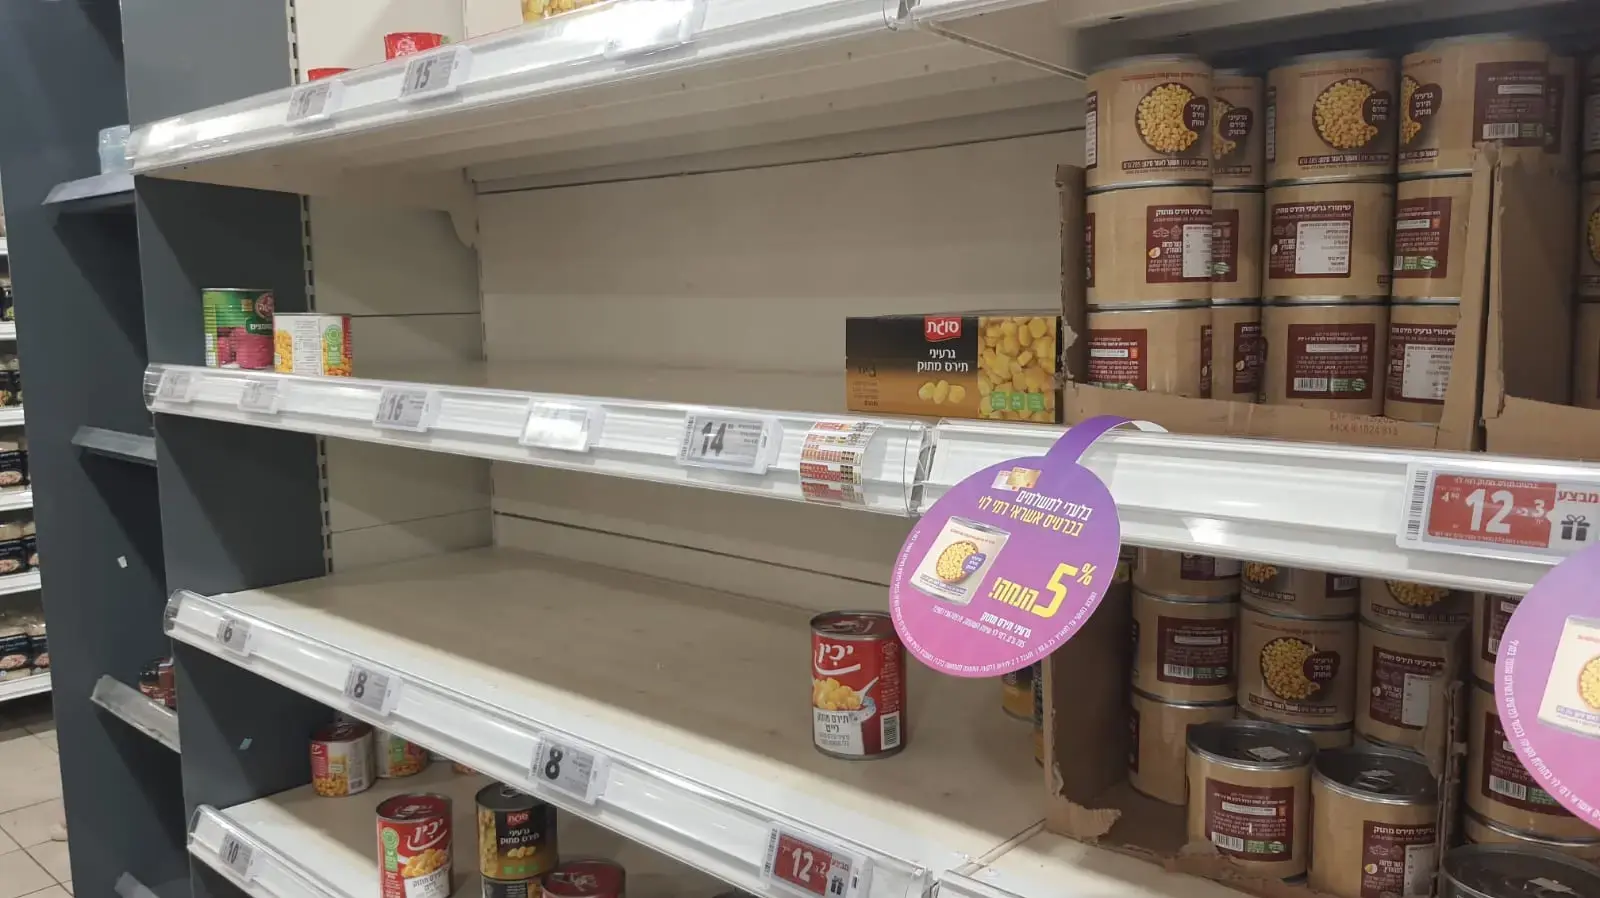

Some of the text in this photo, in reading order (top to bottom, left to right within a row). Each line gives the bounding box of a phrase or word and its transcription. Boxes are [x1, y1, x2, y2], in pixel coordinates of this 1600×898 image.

[926, 320, 960, 335] סוגת
[929, 348, 956, 359] גרעיני
[916, 361, 969, 373] תירס מתוק
[701, 421, 727, 457] 14
[1557, 490, 1600, 503] מבצע
[1016, 489, 1093, 521] בלעדי למשלמים
[1465, 488, 1514, 534] 12
[1531, 499, 1545, 518] 3
[978, 495, 1084, 537] בכרטיס אשראי רמי לוי
[988, 576, 1040, 612] הנחה!
[979, 611, 998, 625] מתוק
[997, 617, 1014, 631] תירס
[1013, 623, 1032, 639] גרעיני
[818, 643, 854, 667] יכין
[353, 670, 368, 699] 8
[832, 713, 849, 724] תירס
[545, 745, 563, 780] 8
[1572, 793, 1592, 814] אשראי
[508, 813, 529, 822] סוגת
[413, 818, 444, 844] יכין
[508, 827, 530, 835] גרעיני
[1373, 825, 1394, 834] מתוק
[1395, 827, 1415, 835] תירס
[500, 833, 540, 845] תירס מתוק
[792, 847, 814, 883] 12
[831, 857, 849, 872] מבצע
